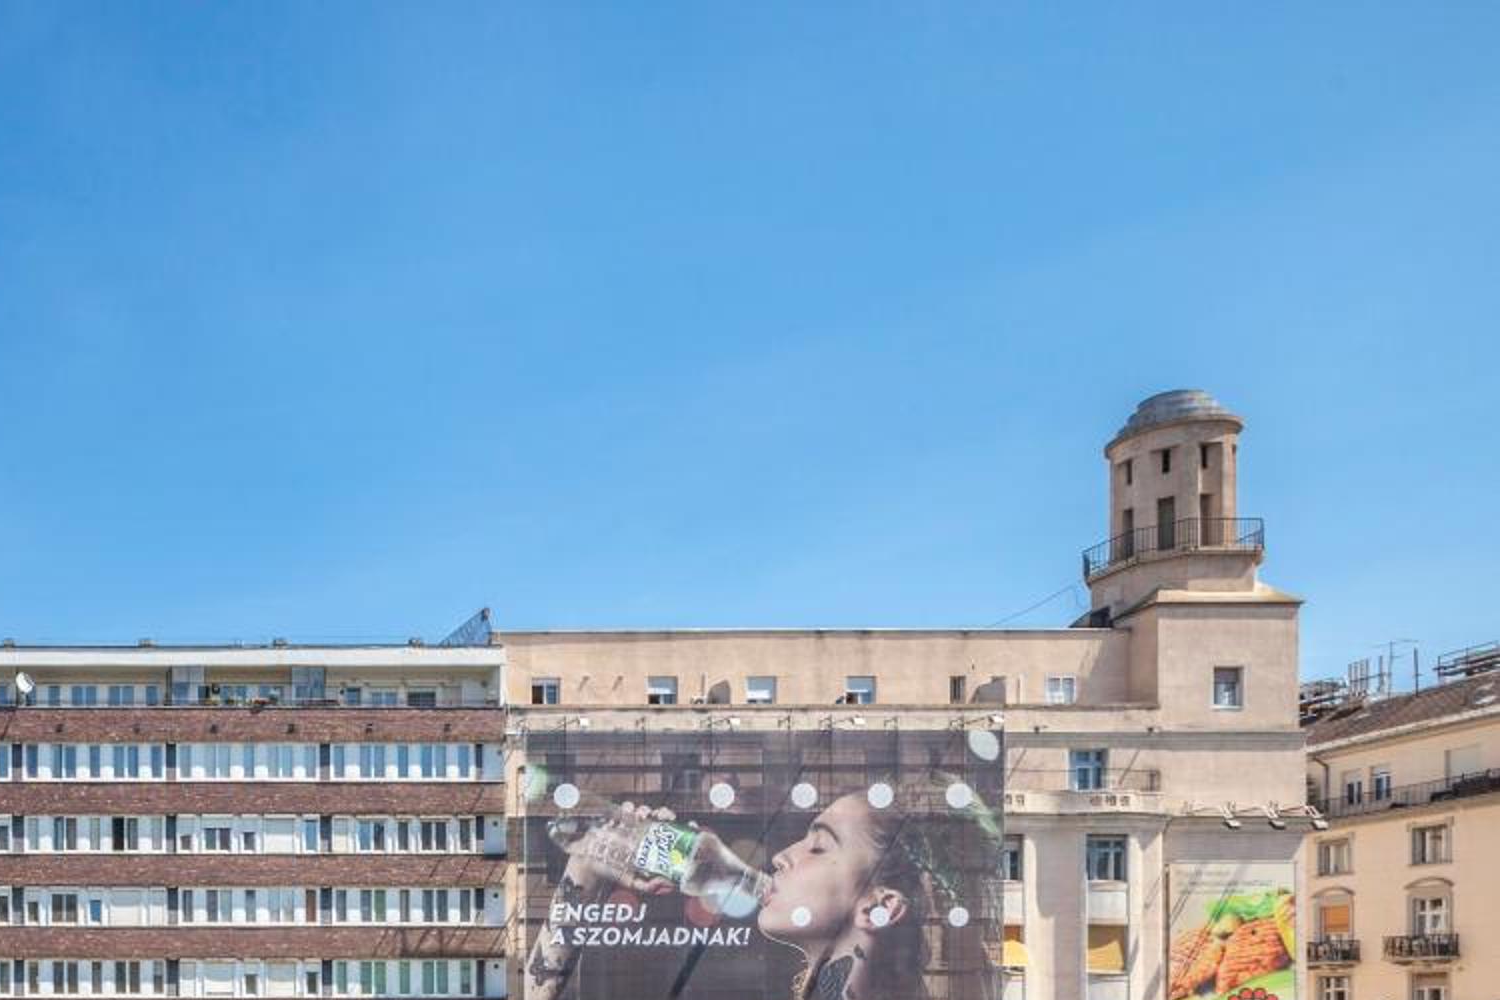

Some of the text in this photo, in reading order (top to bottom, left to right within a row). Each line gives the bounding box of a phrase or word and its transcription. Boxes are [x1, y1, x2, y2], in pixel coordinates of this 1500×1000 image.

[550, 903, 647, 923] ENGEDJ
[551, 927, 752, 946] A SZOMJADNAK!
